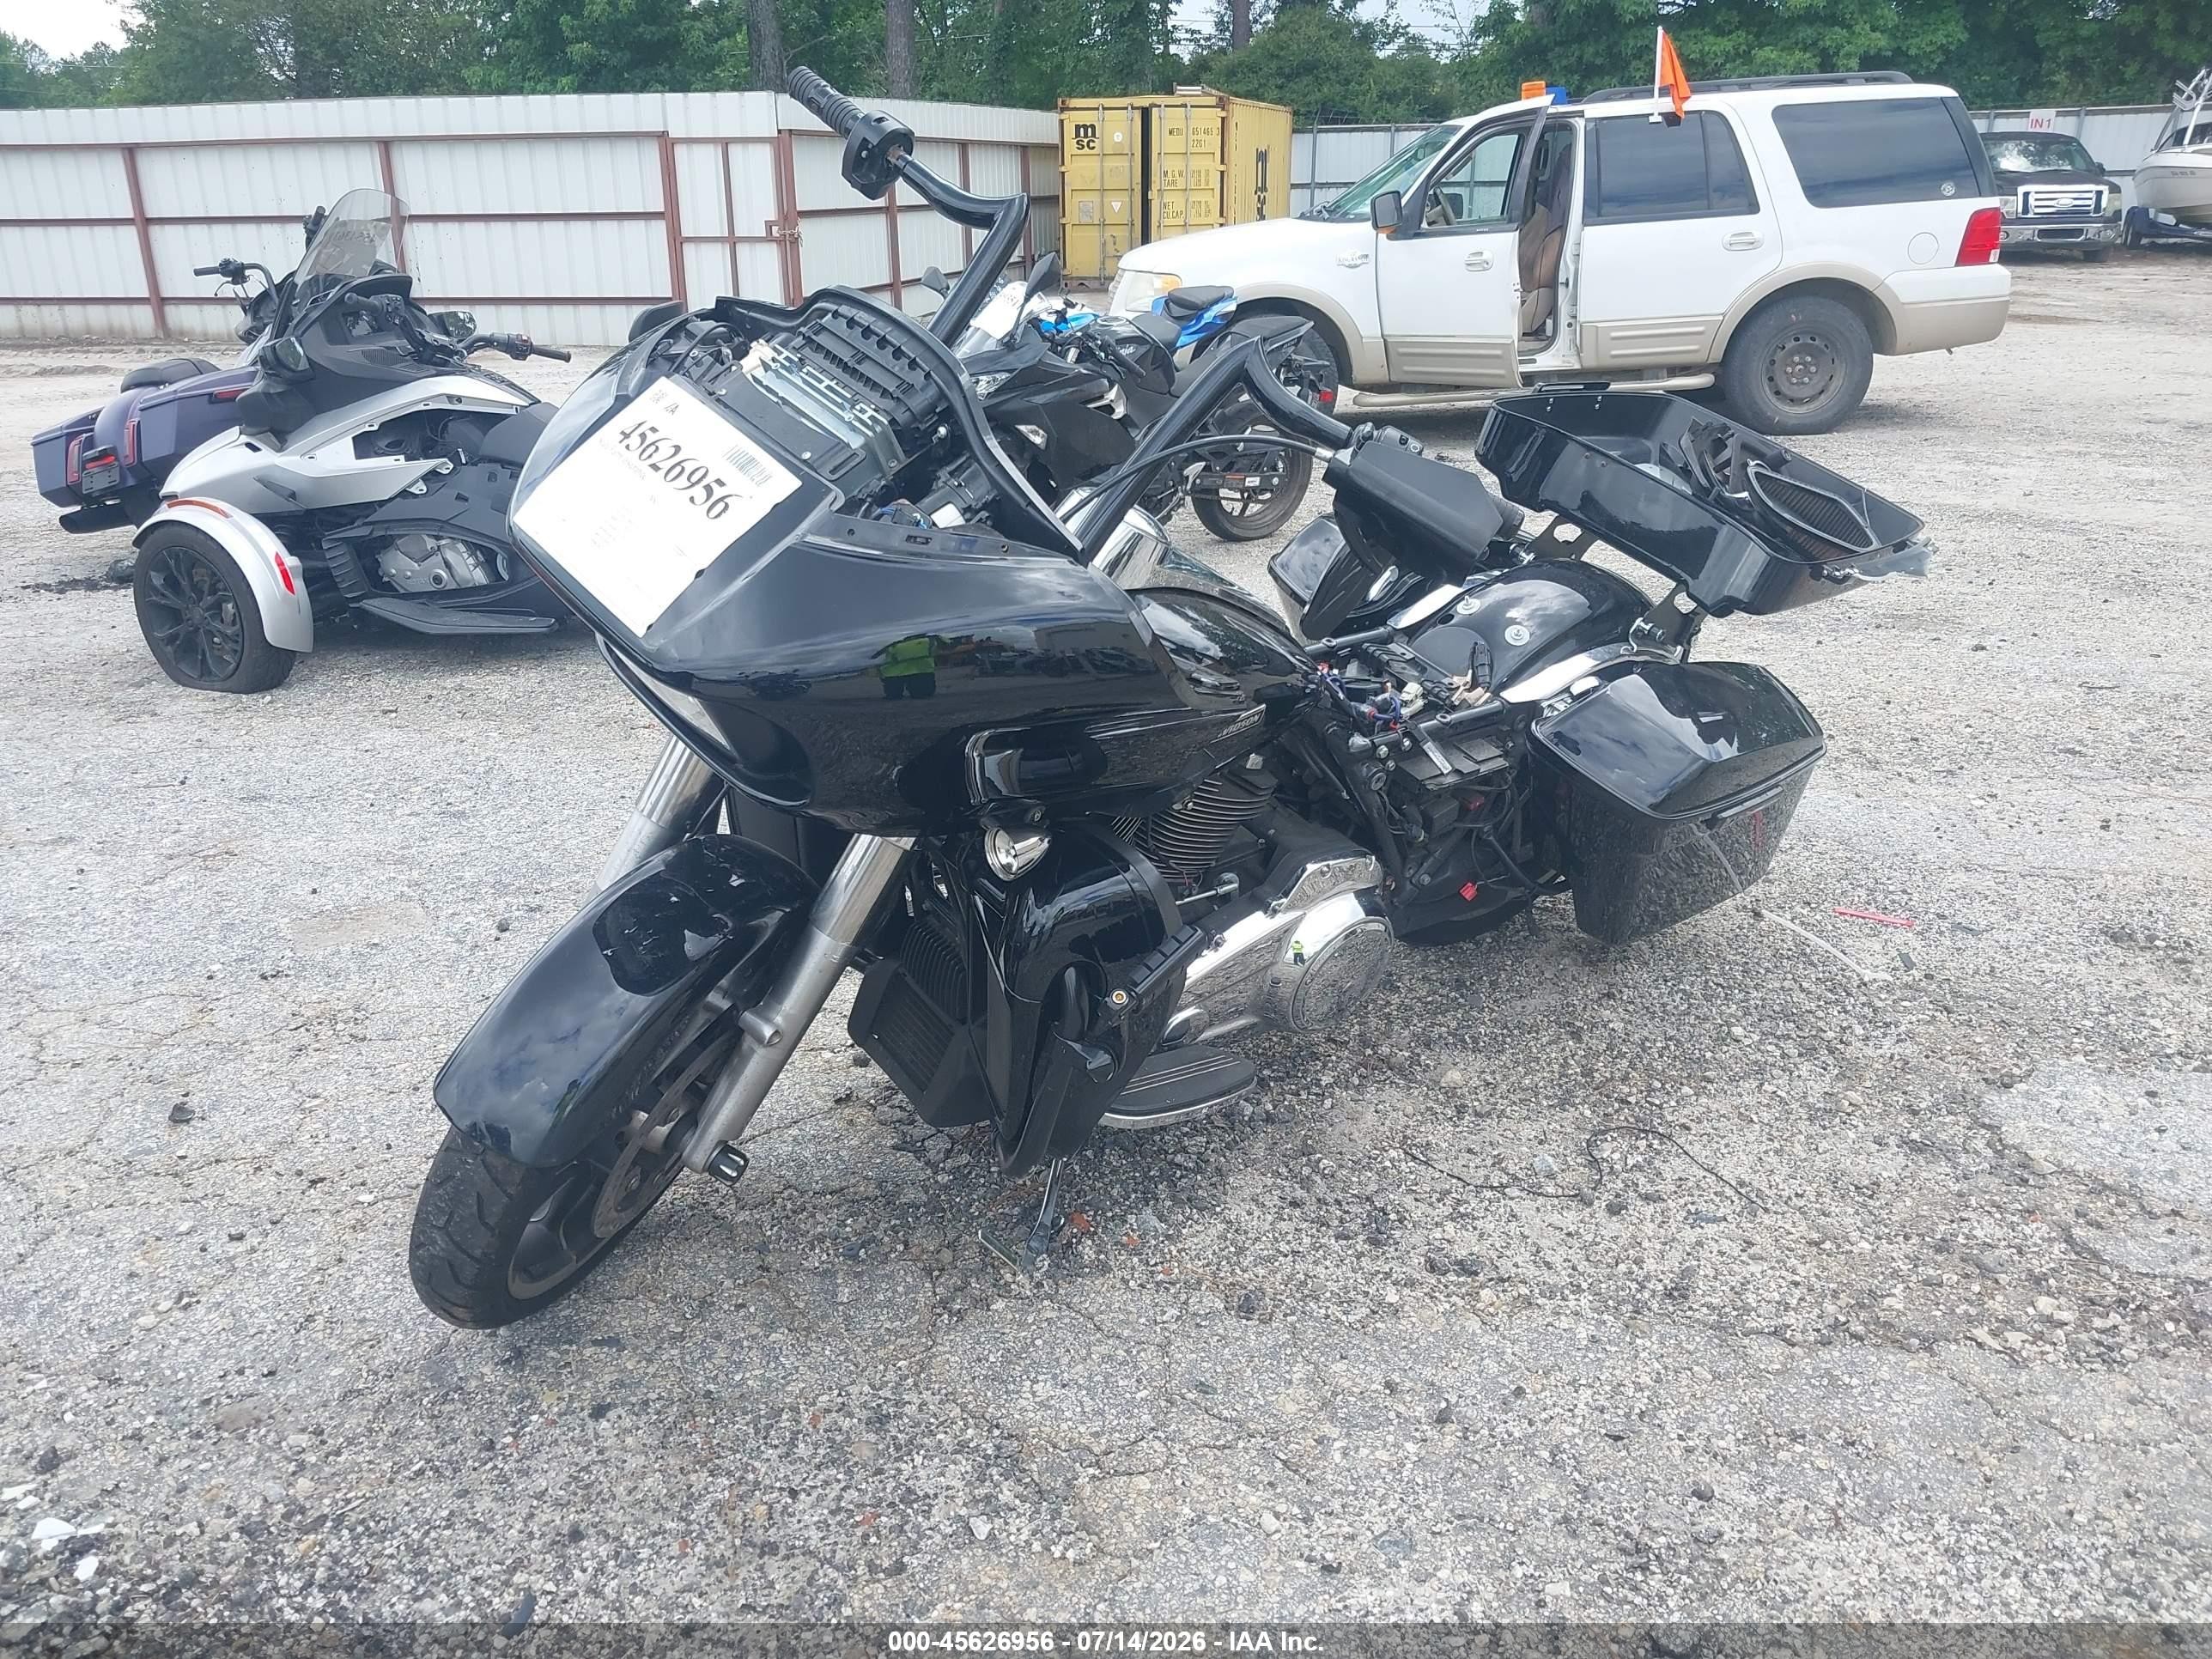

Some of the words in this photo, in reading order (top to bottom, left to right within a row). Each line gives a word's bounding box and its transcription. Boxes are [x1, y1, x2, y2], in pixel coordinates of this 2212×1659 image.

[2030, 118, 2044, 129] IN
[2046, 118, 2051, 129] 1
[1168, 127, 1184, 137] MEDU
[1216, 127, 1220, 136] 3
[1163, 179, 1178, 187] TARE
[1163, 201, 1175, 210] NET
[617, 419, 744, 520] 45626956
